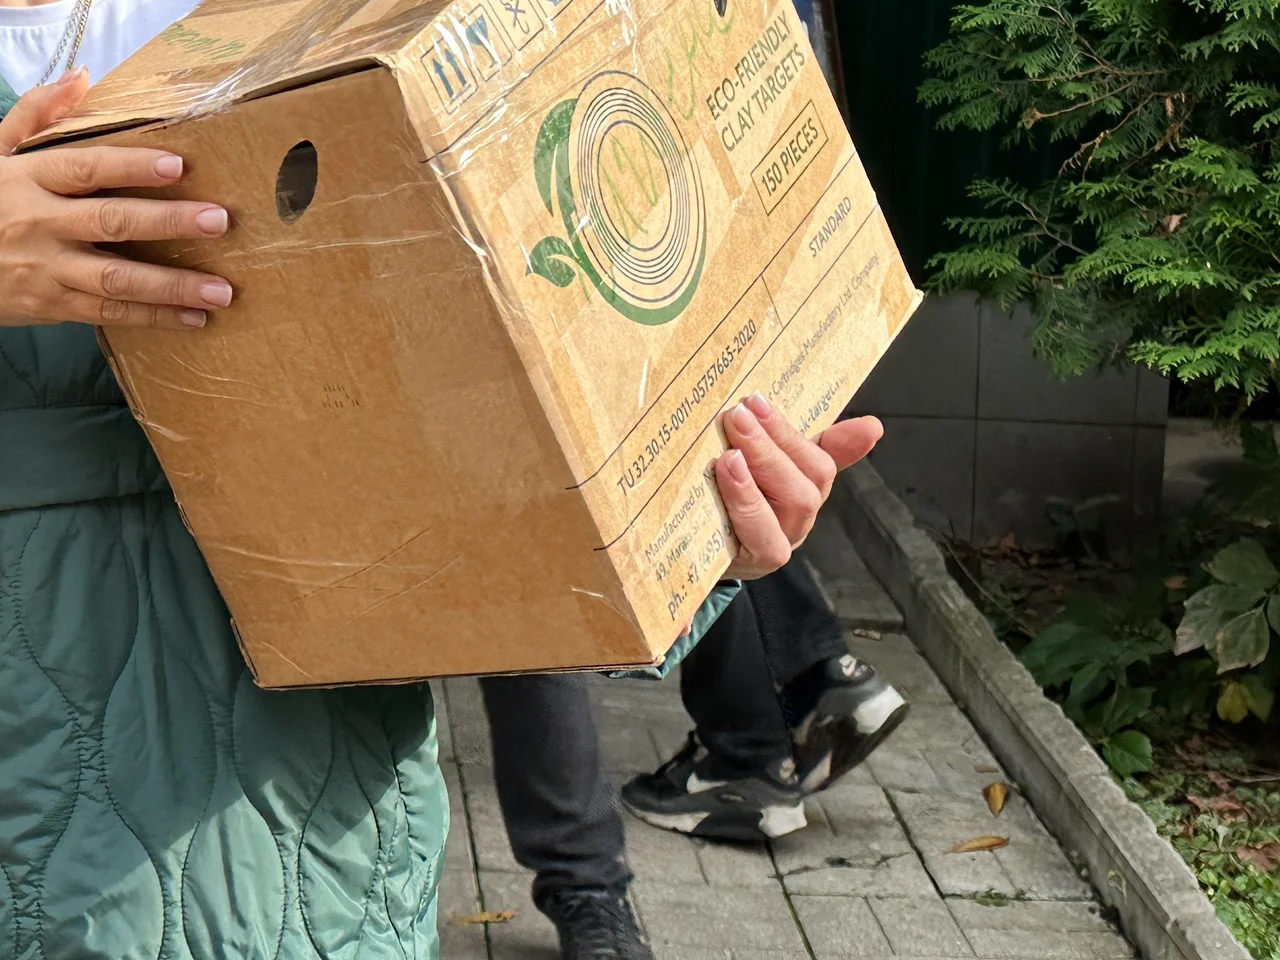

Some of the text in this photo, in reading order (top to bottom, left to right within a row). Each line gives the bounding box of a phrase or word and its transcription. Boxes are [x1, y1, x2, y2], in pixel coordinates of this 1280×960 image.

[705, 10, 792, 121] ECO-FRIENDLY
[721, 43, 806, 153] CLAY TARGETS
[761, 117, 820, 197] 150 PIECES
[808, 197, 852, 258] STANDARD
[616, 472, 635, 497] TU
[645, 482, 706, 564] Manufactured by
[667, 584, 689, 621] ph.:
